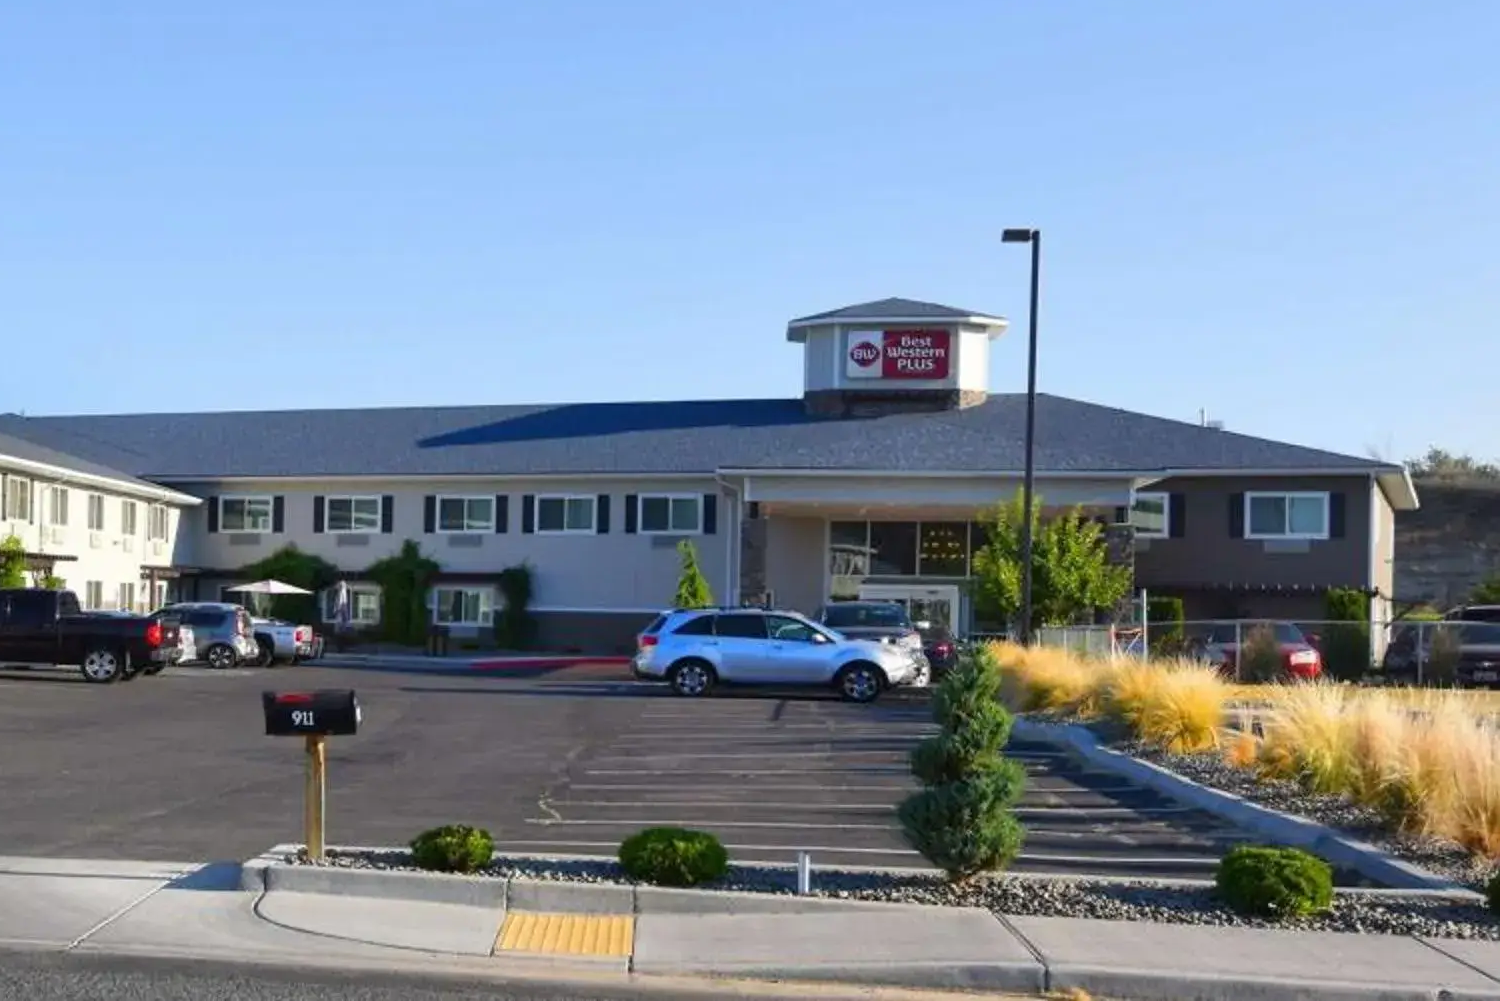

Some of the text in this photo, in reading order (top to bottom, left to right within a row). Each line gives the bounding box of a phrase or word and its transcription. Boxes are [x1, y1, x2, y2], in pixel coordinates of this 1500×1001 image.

[901, 336, 932, 348] Best
[853, 349, 877, 360] BW
[887, 346, 945, 359] Western
[897, 358, 934, 370] PLUS
[291, 710, 315, 726] 911
